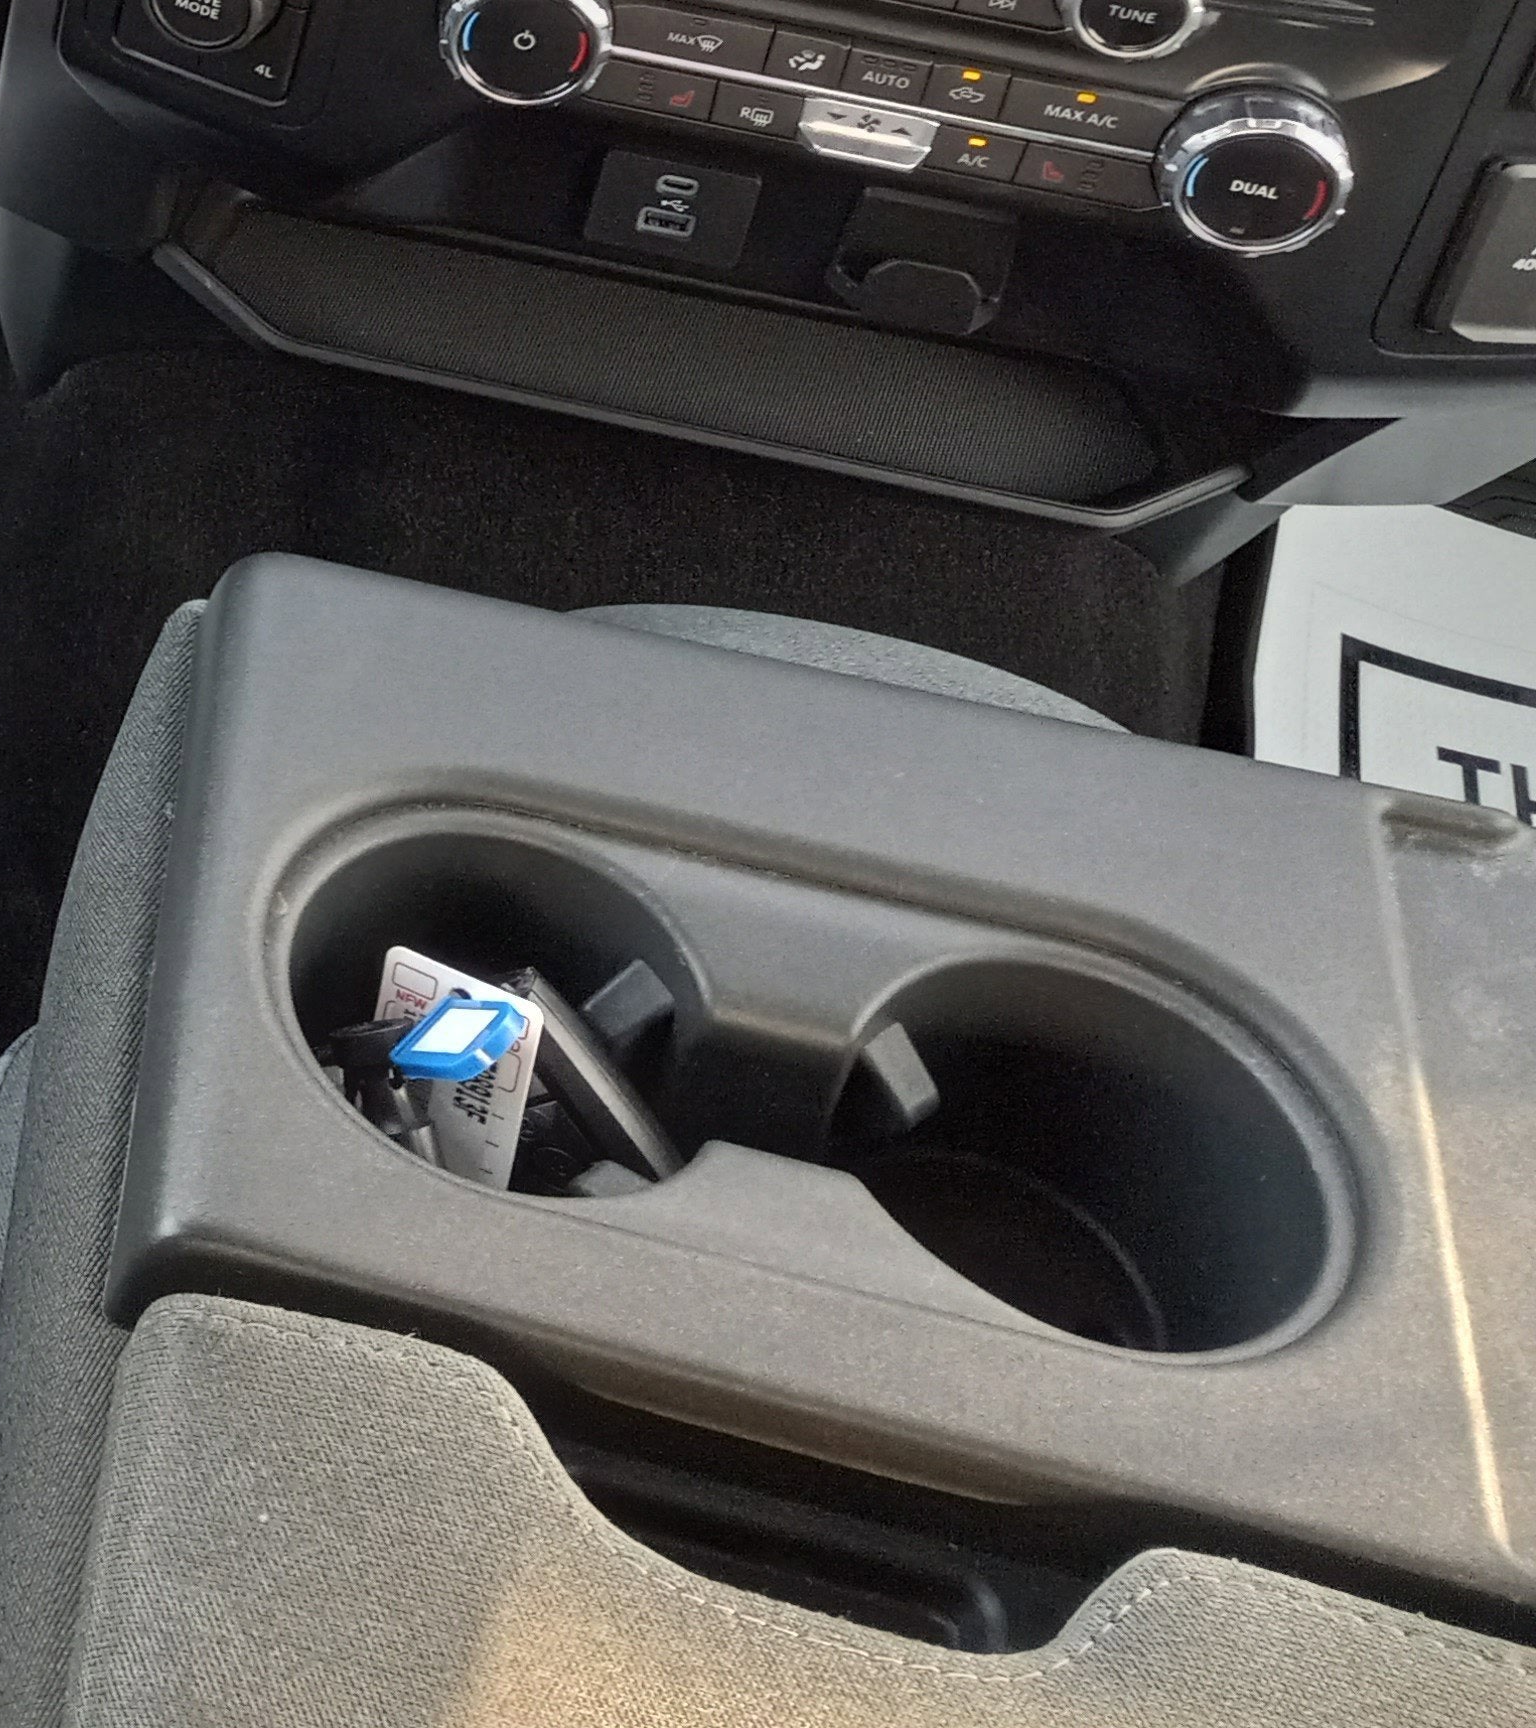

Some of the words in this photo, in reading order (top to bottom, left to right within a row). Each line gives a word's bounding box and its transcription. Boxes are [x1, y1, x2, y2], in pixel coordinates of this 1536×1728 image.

[1108, 4, 1159, 25] TUNE
[667, 31, 697, 46] MAX
[254, 62, 276, 80] 4L
[861, 70, 910, 90] AUTO
[1044, 104, 1082, 121] MAX
[1086, 110, 1119, 129] A/C
[956, 152, 991, 169] A/C
[1229, 179, 1279, 200] DUAL
